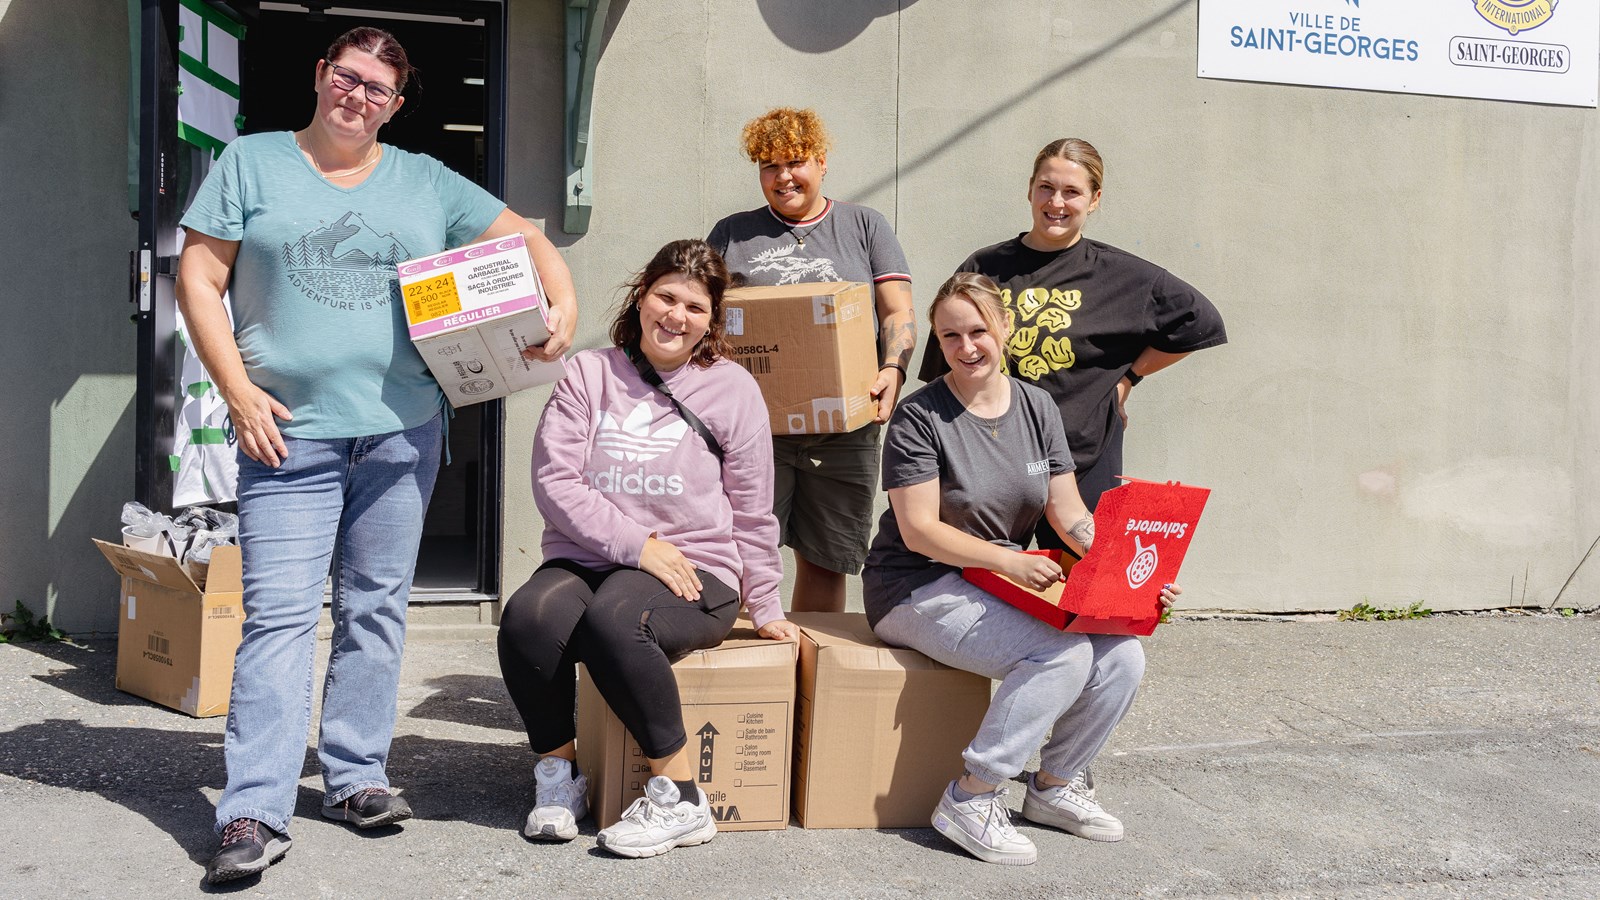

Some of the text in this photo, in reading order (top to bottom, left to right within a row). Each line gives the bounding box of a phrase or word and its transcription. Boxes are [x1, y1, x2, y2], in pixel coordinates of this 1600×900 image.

[1289, 12, 1361, 32] VILLE DE
[1481, 0, 1547, 25] INTERNATIONAL
[1230, 25, 1419, 62] SAINT-GEORGES
[1457, 41, 1564, 69] SAINT-GEORGES
[468, 267, 500, 280] GARBAGE
[501, 262, 519, 271] BAGS
[473, 259, 511, 272] INDUSTRIAL
[409, 278, 449, 297] 22 x 24
[467, 282, 485, 291] SACS
[492, 272, 524, 284] ORDURES
[478, 281, 516, 294] INDUSTRIEL
[287, 273, 355, 311] ADVENTURE
[361, 301, 372, 311] IS
[420, 293, 438, 304] 500
[443, 305, 501, 328] RÉGULIER
[582, 465, 684, 496] adidas
[1125, 519, 1188, 538] Salvatoré
[701, 731, 713, 781] HAUT
[709, 805, 742, 821] NA
